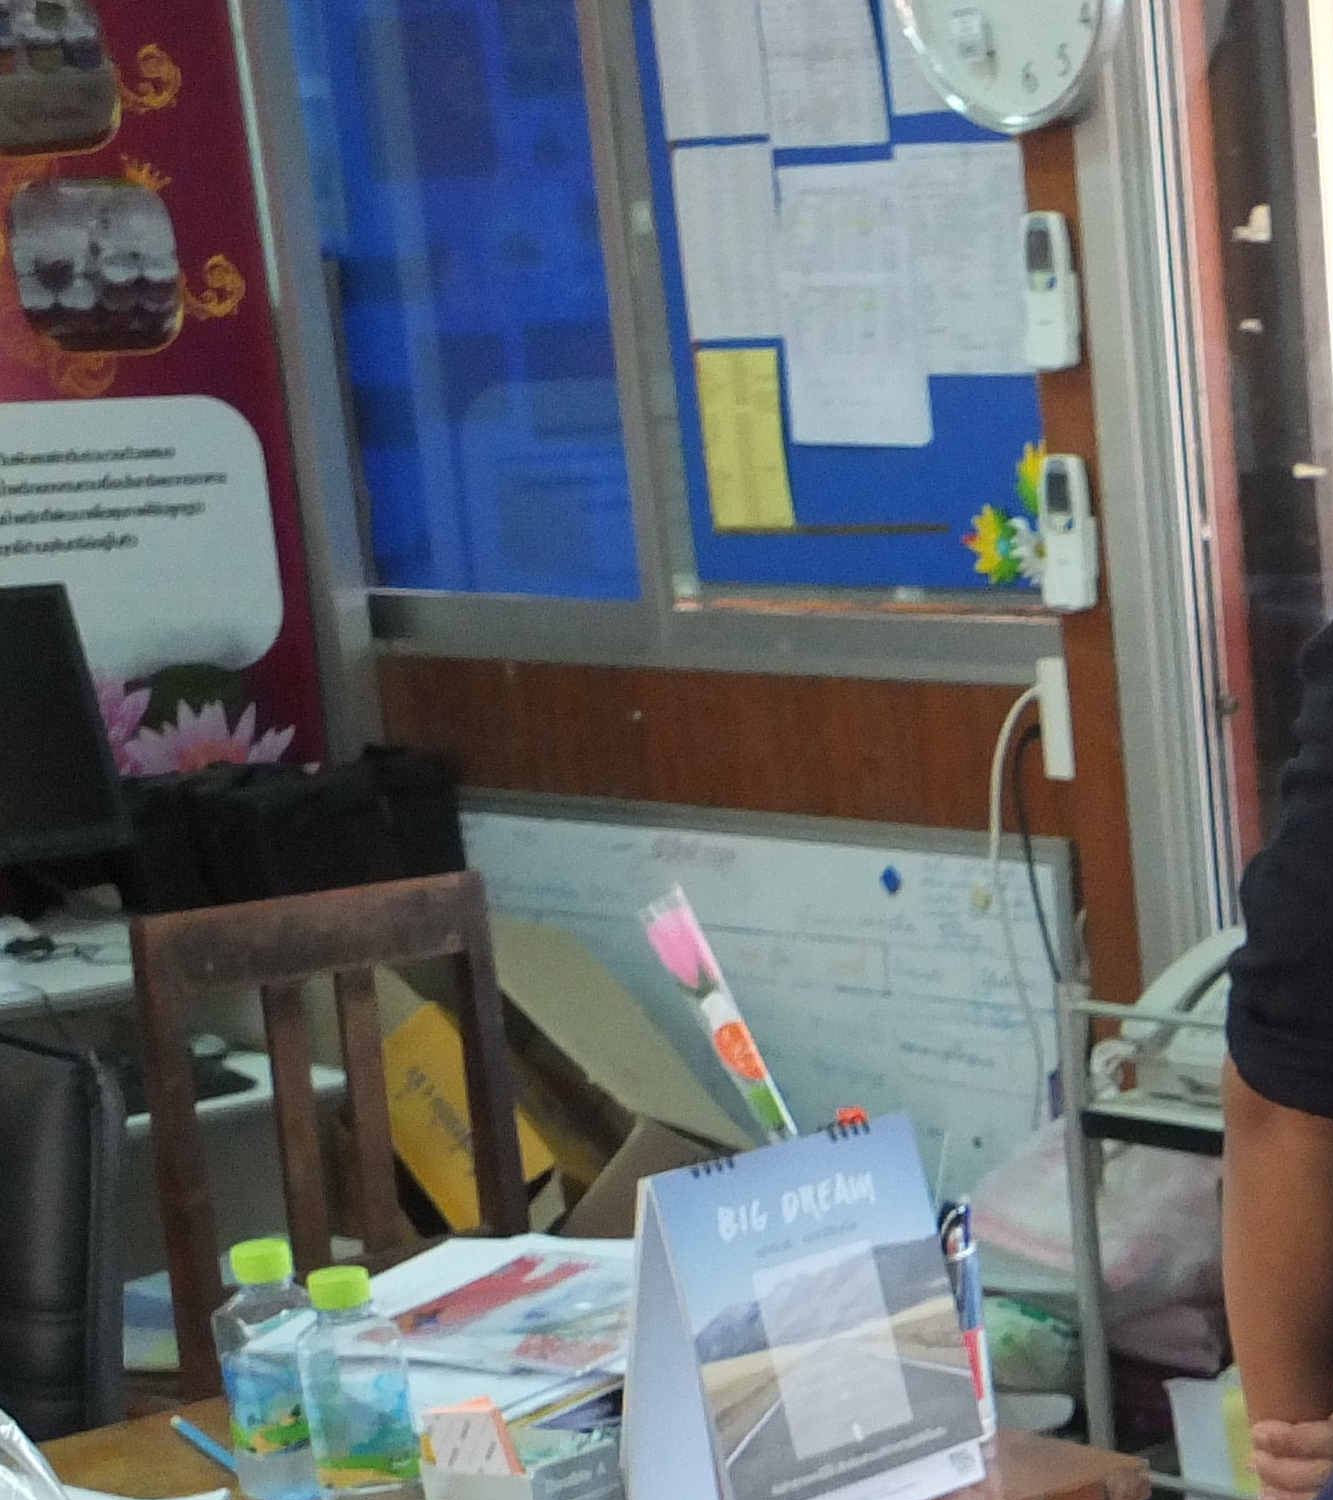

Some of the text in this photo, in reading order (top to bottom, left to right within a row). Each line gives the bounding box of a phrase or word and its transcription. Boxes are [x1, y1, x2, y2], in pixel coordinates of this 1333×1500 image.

[1057, 43, 1071, 77] 5
[1021, 61, 1040, 94] 6
[718, 1195, 767, 1241] BIG
[781, 1170, 877, 1226] DREAM
